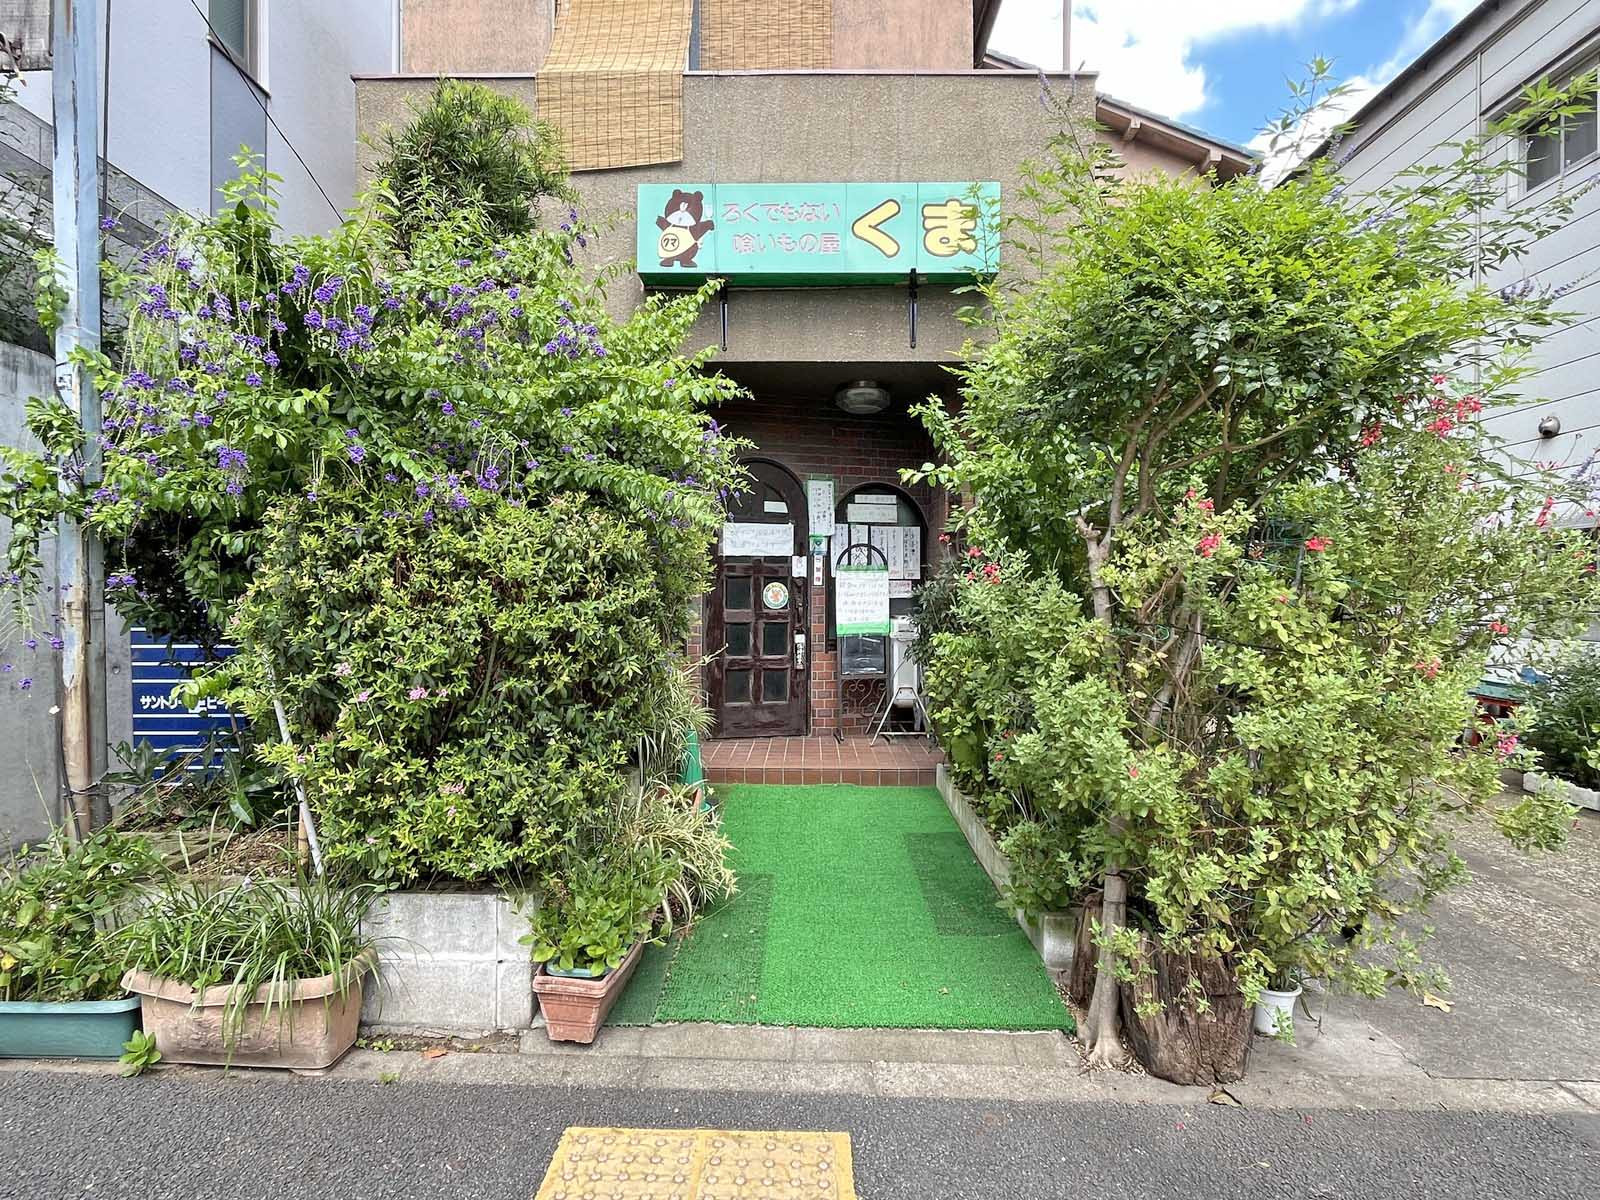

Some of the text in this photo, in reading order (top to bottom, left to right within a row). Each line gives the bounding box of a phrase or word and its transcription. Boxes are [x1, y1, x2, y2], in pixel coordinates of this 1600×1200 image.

[722, 201, 842, 223] ろくでもない
[851, 198, 979, 258] くま
[662, 237, 678, 248] クマ
[732, 232, 842, 254] 喰いもの屋
